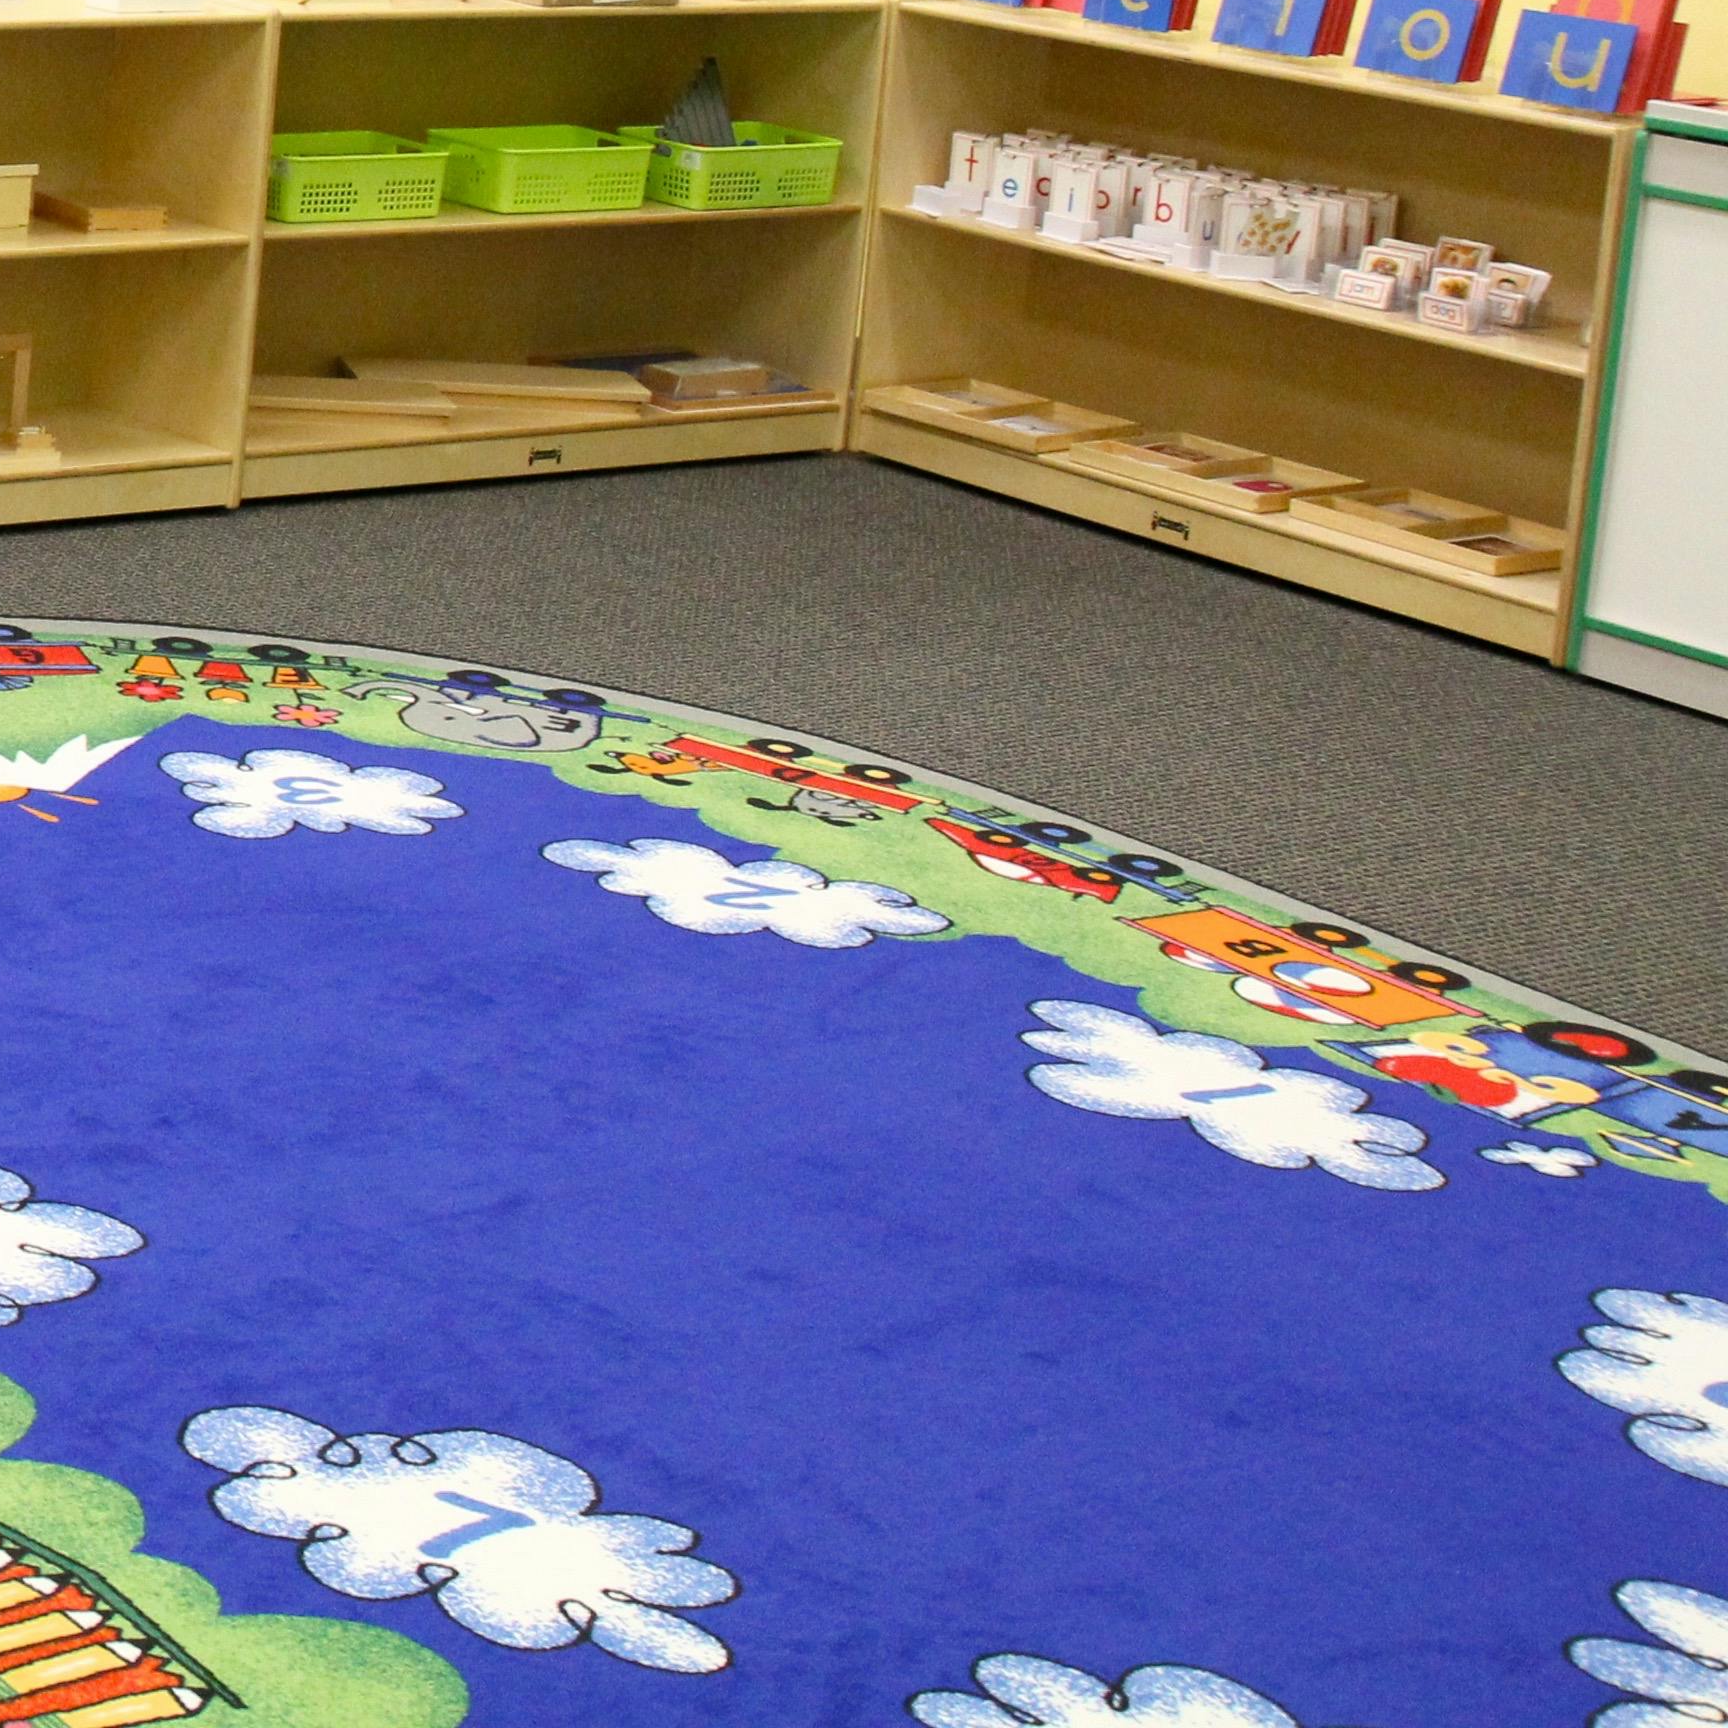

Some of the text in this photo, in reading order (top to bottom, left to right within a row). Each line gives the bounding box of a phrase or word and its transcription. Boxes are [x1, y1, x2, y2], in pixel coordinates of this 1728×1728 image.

[1399, 8, 1450, 61] o
[1550, 32, 1612, 92] u
[964, 145, 978, 182] t
[1002, 178, 1018, 198] e
[1067, 187, 1075, 213] i
[1154, 183, 1173, 223] b
[541, 714, 581, 734] E
[273, 776, 343, 805] 3
[705, 877, 799, 910] 2
[1224, 939, 1288, 959] B
[1181, 1082, 1276, 1106] 1
[418, 1489, 538, 1560] 7
